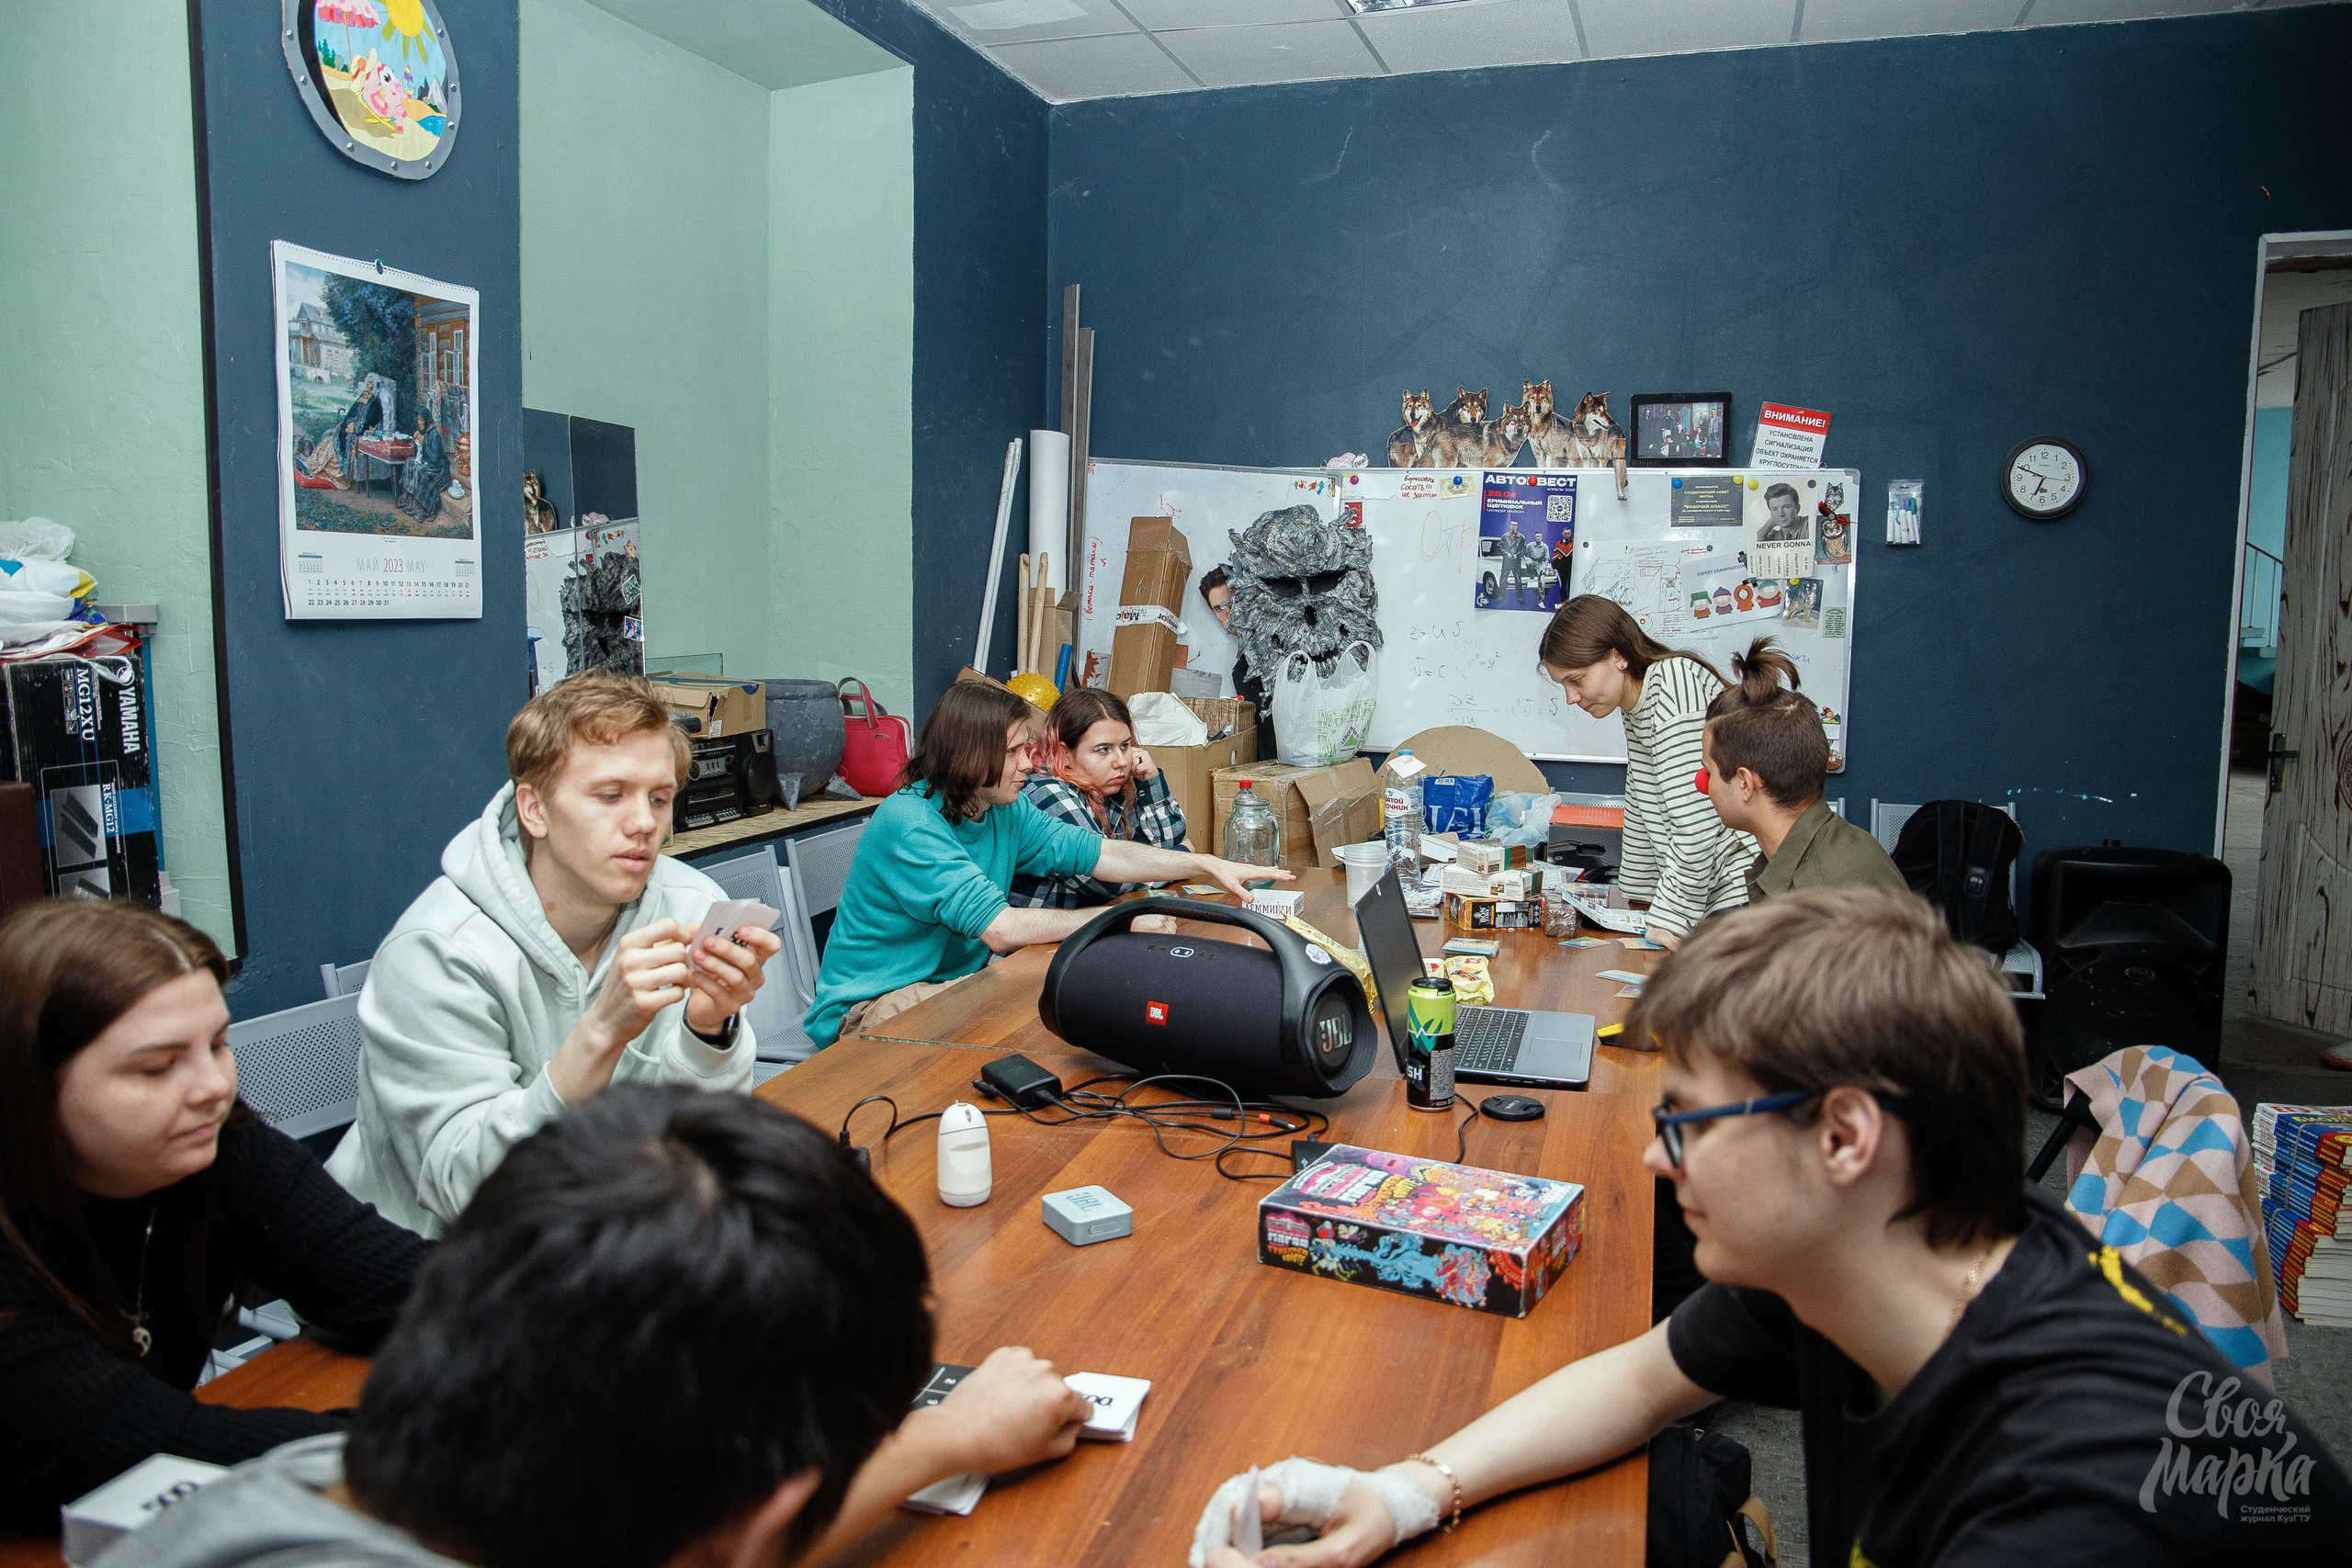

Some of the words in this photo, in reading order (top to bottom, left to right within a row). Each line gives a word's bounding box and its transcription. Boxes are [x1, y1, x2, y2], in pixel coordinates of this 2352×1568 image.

[1764, 410, 1826, 428] ВНИМАНИЕ!
[1769, 429, 1813, 443] УСТАНОВЛЕНА
[1764, 439, 1814, 453] СИГНАЛИЗАЦИЯ
[1756, 448, 1779, 457] ОБЪЕКТ
[1780, 452, 1818, 464] ОХРАНЯЕТСЯ
[1485, 474, 1576, 487] АВТОВЕСТ
[357, 557, 379, 571] МАЙ
[384, 558, 403, 572] 2023
[407, 561, 426, 573] MAY
[1714, 564, 1745, 573] EXAMINATION
[1116, 610, 1139, 623] Majo
[76, 668, 95, 741] MG12XU
[118, 686, 140, 754] YAMAHA
[102, 783, 115, 833] RK-MG12
[1149, 1006, 1164, 1020] JBL
[1318, 1013, 1352, 1053] JBL
[1066, 1192, 1102, 1212] JBL
